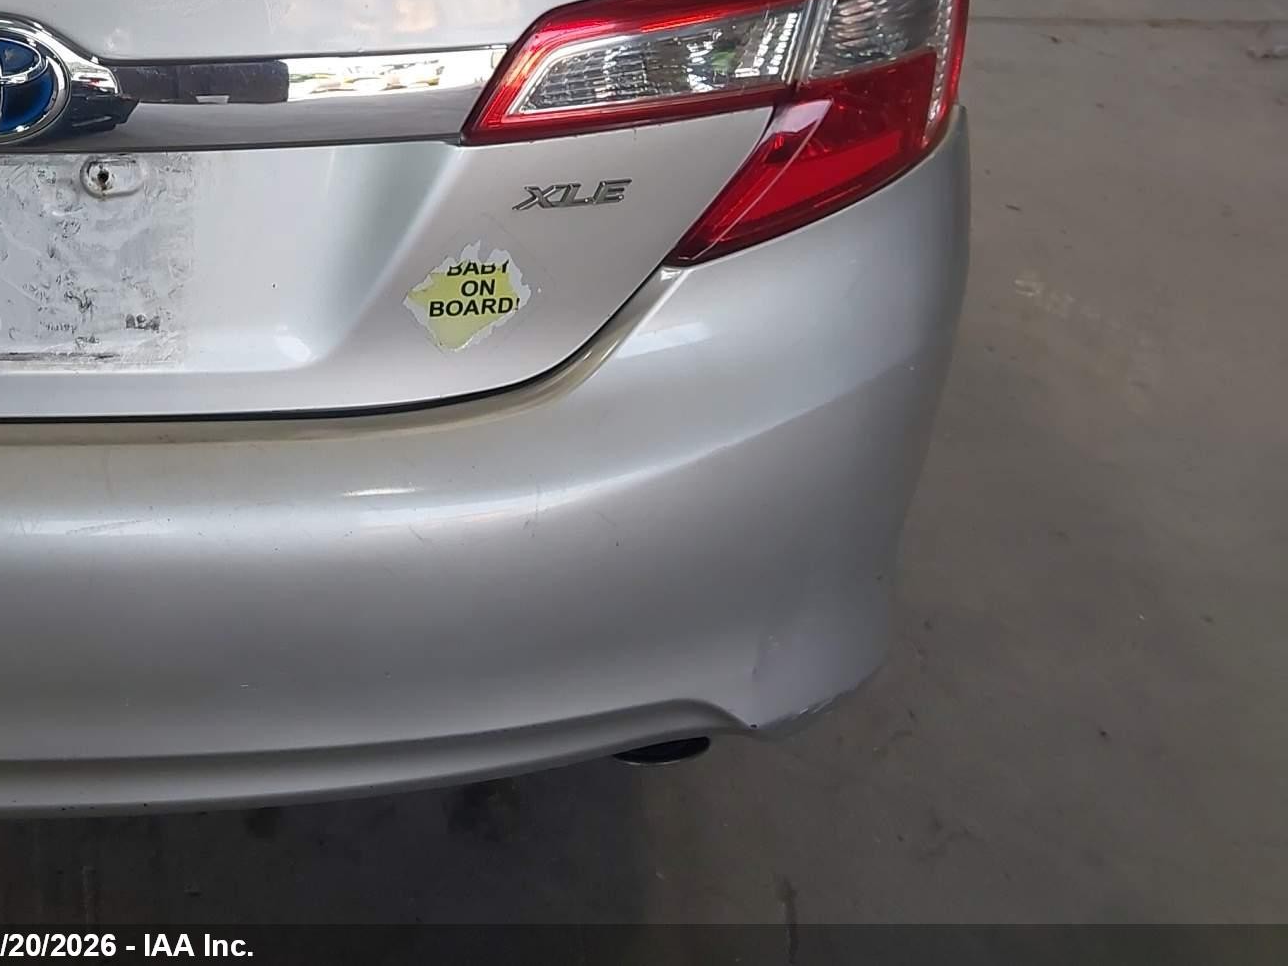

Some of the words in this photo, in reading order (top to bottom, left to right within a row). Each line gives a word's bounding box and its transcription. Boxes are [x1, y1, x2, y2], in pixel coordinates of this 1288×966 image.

[512, 179, 632, 210] XLE
[460, 278, 495, 297] ON
[429, 297, 520, 317] BOARD!
